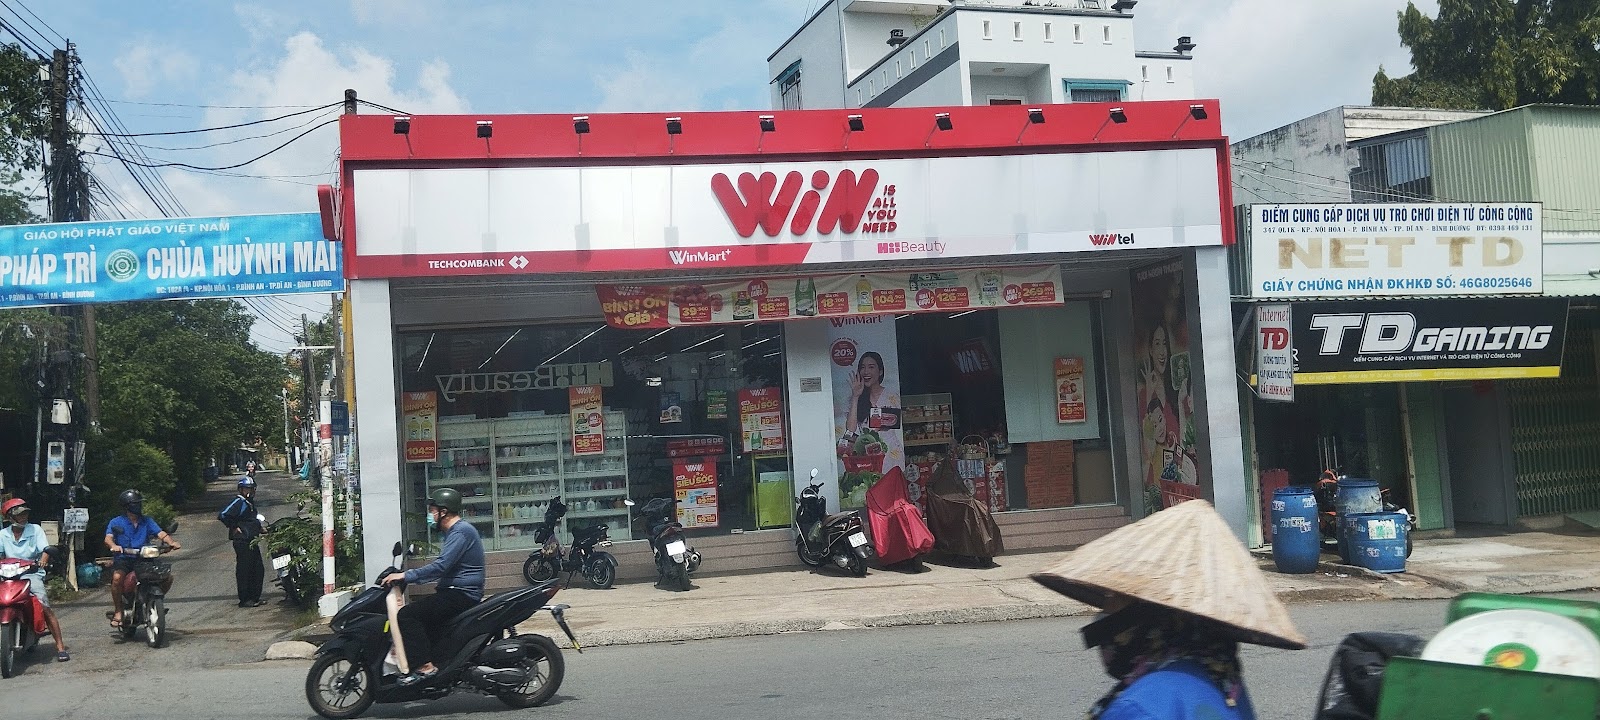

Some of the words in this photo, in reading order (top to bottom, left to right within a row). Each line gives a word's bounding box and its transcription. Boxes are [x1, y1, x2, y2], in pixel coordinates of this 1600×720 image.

[883, 184, 897, 196] IS
[872, 197, 897, 209] ALL
[867, 209, 897, 221] YOU
[1262, 204, 1289, 223] ĐIỂM
[1293, 208, 1320, 223] CUNG
[1323, 204, 1343, 223] CẤP
[1346, 208, 1370, 225] DỊCH
[1373, 208, 1386, 225] VỤ
[1389, 205, 1408, 222] TRÒ
[1411, 207, 1434, 222] CHƠI
[1437, 205, 1460, 224] ĐIỆN
[1463, 204, 1475, 222] TỬ
[1478, 205, 1504, 222] CÔNG
[1507, 205, 1533, 223] CỘNG
[24, 228, 60, 241] GIÁO
[61, 227, 84, 240] HỘI
[88, 226, 124, 238] PHẬT
[127, 224, 163, 236] GIÁO
[164, 223, 196, 236] VIỆT
[199, 222, 231, 233] NAM
[862, 221, 897, 233] NEED
[1278, 236, 1416, 270] NET
[1436, 236, 1525, 268] TD
[0, 247, 58, 287] PHÁP
[63, 244, 97, 284] TRÌ
[147, 240, 206, 280] CHÙA
[213, 237, 287, 277] HUỲNH
[293, 240, 337, 273] MAI
[428, 258, 505, 269] TECHCOMBANK
[1262, 276, 1294, 292] GIẤY
[1298, 277, 1343, 291] CHỨNG
[1347, 276, 1383, 292] NHẬN
[1387, 278, 1432, 289] ĐKHKĐ
[1436, 274, 1456, 289] SỐ:
[1459, 277, 1533, 288] 46G8025646
[623, 309, 651, 326] Giá
[1259, 307, 1289, 322] Internet
[1260, 327, 1289, 350] TD
[1309, 312, 1417, 356] TD
[1412, 325, 1554, 352] GAMING
[834, 348, 854, 357] 20%
[676, 475, 695, 488] SIÊU
[695, 473, 714, 484] SỐC
